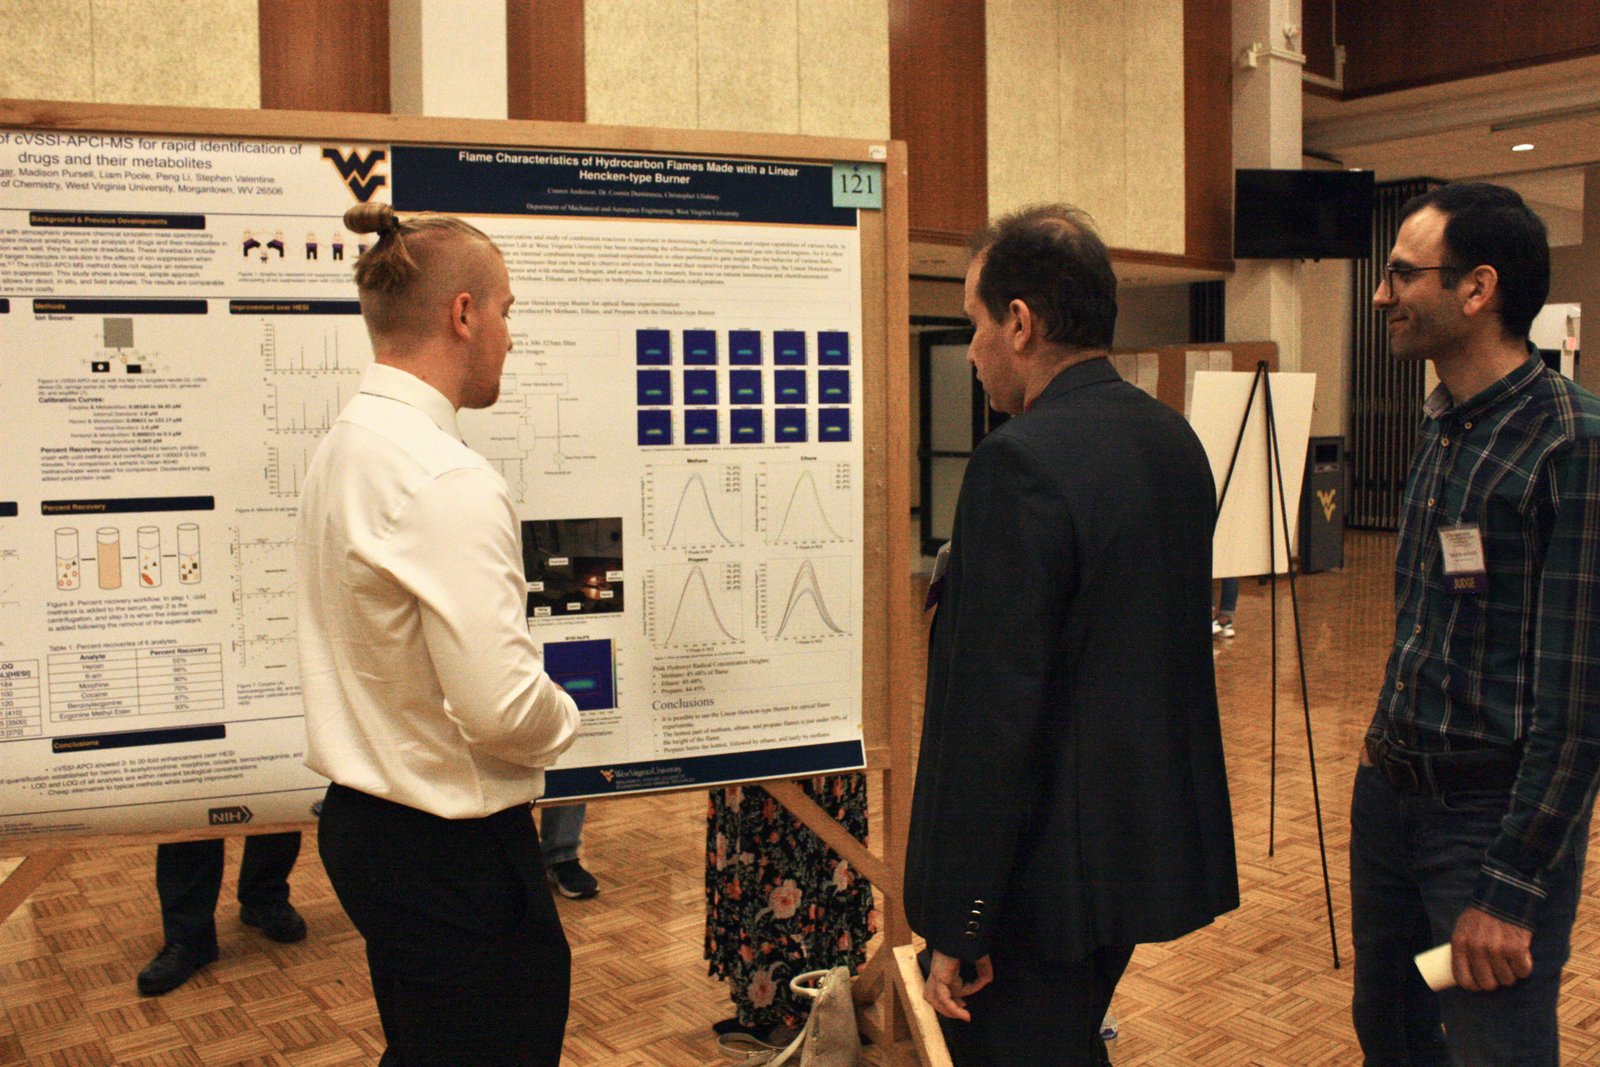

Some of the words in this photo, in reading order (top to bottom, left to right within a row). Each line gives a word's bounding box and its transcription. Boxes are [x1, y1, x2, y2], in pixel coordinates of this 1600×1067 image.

[14, 133, 134, 150] cVSSI-APCI-MS
[138, 138, 158, 150] for
[162, 140, 196, 153] rapid
[200, 141, 286, 154] identification
[289, 144, 302, 155] of
[18, 152, 60, 167] drugs
[64, 154, 92, 166] and
[96, 154, 128, 167] their
[132, 156, 212, 170] metabolites
[458, 151, 494, 162] Flame
[496, 152, 579, 166] Characteristics
[582, 156, 593, 166] of
[596, 156, 664, 170] Hydrocarbon
[666, 160, 704, 172] Flames
[706, 162, 734, 173] Made
[736, 164, 758, 174] with
[768, 165, 800, 176] Linear
[579, 170, 652, 184] Hencken-type
[654, 173, 690, 185] Burner
[840, 174, 874, 194] 121
[652, 698, 715, 711] Conclusions
[212, 811, 240, 822] NIH
